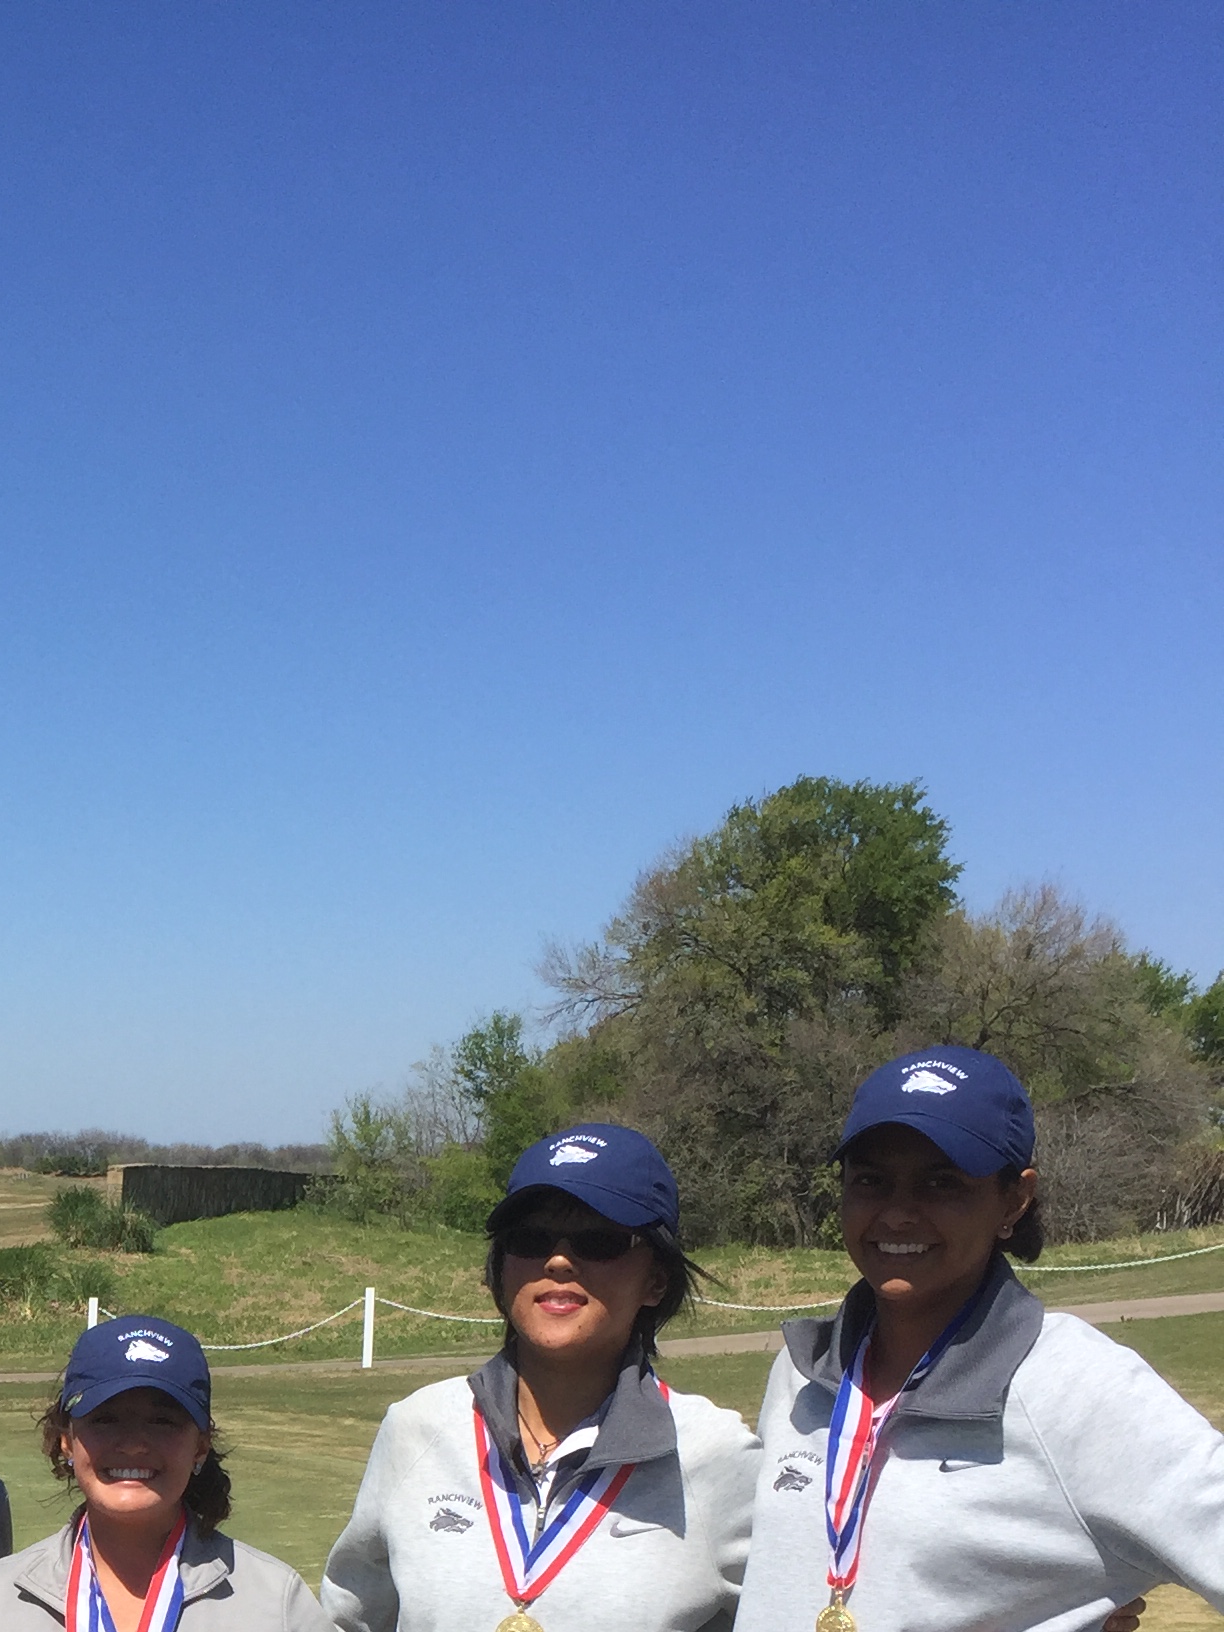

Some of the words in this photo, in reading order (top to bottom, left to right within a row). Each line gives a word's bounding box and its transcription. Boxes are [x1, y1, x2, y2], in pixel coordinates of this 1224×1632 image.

[901, 1060, 969, 1080] RANCHVIEW
[549, 1134, 609, 1151] RANCHVIEW
[117, 1329, 174, 1347] RANCHVIEW
[777, 1450, 824, 1466] RANCHVIEW
[427, 1493, 483, 1510] RANCHVIEW
